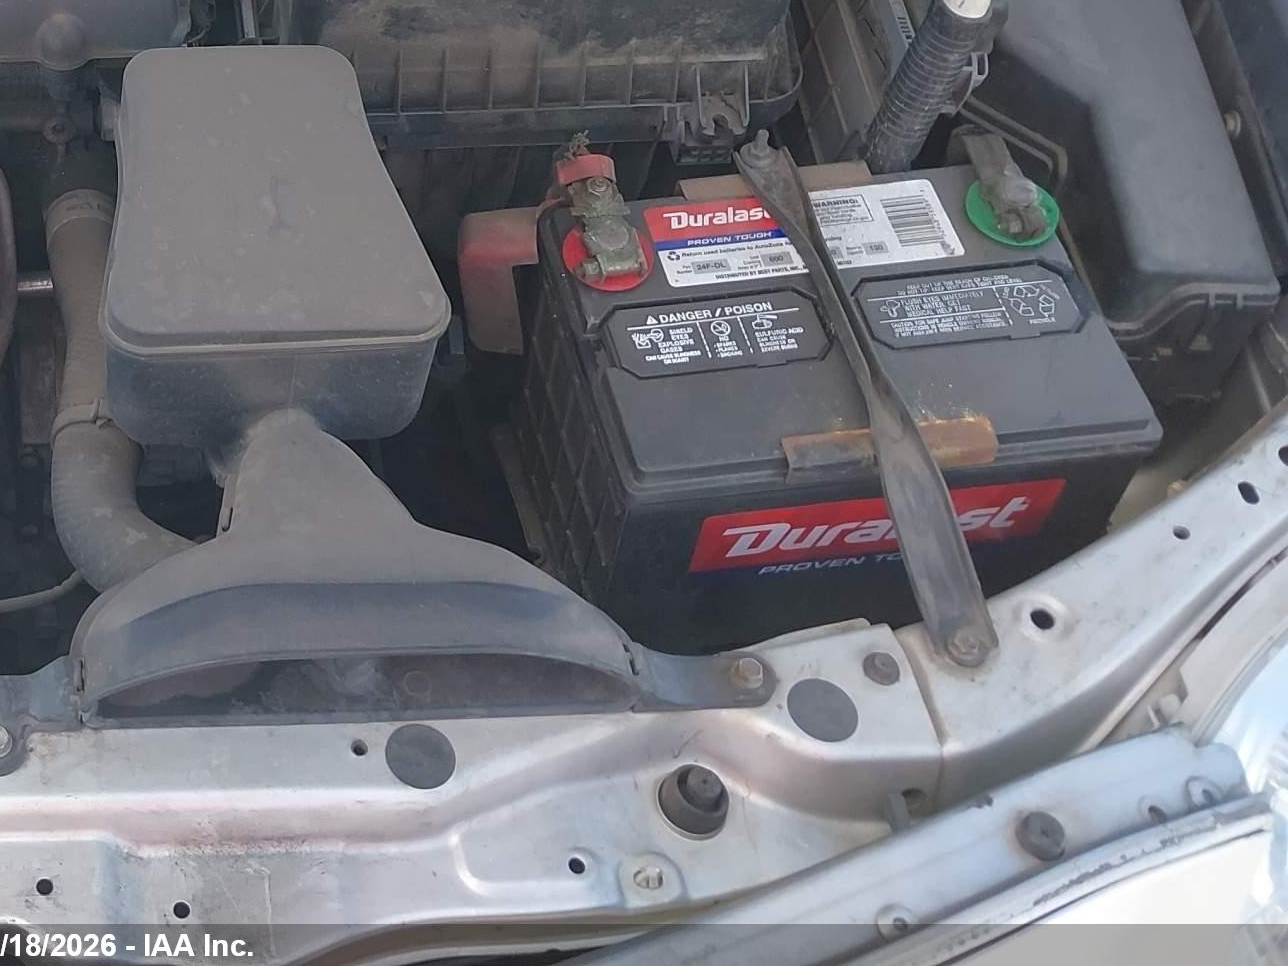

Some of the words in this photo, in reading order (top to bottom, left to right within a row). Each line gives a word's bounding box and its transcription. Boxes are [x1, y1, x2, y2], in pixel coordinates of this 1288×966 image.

[687, 235, 732, 247] PROVEN
[734, 231, 773, 242] TOUGH
[658, 309, 712, 324] DANGER
[714, 307, 722, 317] /
[724, 301, 773, 316] POISON
[722, 496, 1031, 558] Durast
[758, 555, 867, 575] PROVEN
